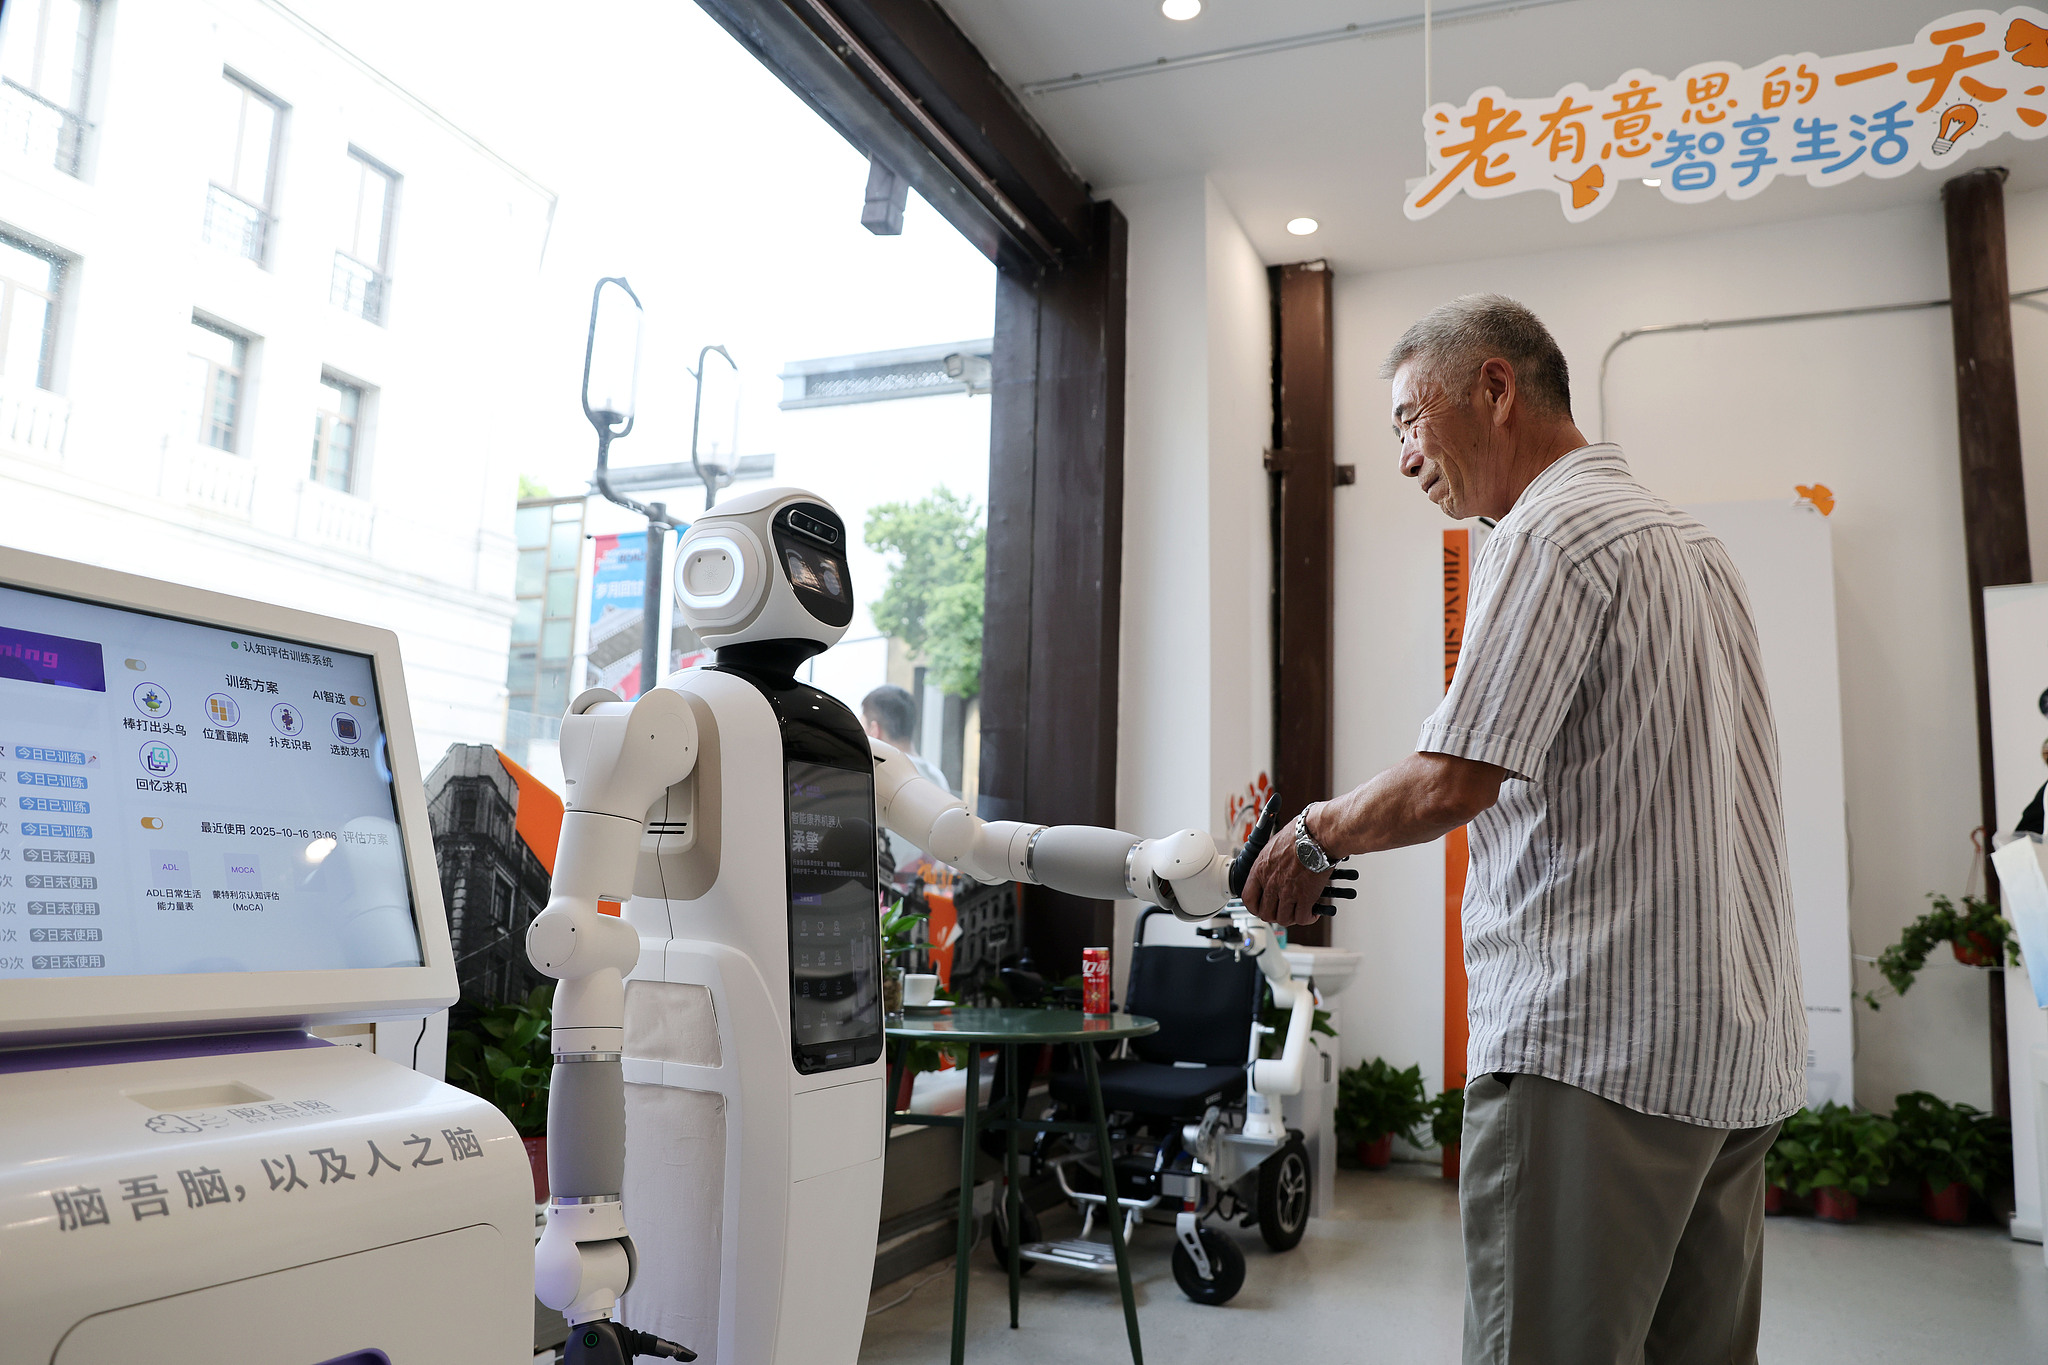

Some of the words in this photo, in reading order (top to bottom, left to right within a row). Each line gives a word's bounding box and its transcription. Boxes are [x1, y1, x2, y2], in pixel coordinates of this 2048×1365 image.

[1415, 22, 2007, 208] 老有意思的一天
[1651, 101, 1914, 191] 智享生活
[243, 641, 333, 668] 认知评估训练系统
[225, 674, 279, 694] 训练方案
[312, 690, 346, 705] AI智选
[123, 717, 187, 736] 棒打出头鸟
[203, 728, 249, 744] 位置翻牌
[269, 736, 312, 751] 扑克识串
[18, 747, 83, 764] 今日已训练
[330, 744, 370, 758] 选数求和
[20, 772, 85, 788] 今日已训练
[136, 778, 188, 794] 回忆求和
[22, 797, 87, 813] 今日已训练
[24, 823, 89, 838] 今日已训练
[201, 821, 246, 835] 最近使用
[250, 826, 309, 839] 2025-10-16
[311, 830, 338, 841] 13:06
[343, 830, 389, 846] 评估方案
[26, 849, 91, 863] 今日未使用
[162, 863, 179, 871] ADL
[231, 866, 255, 874] MOCA
[28, 876, 94, 889] 今日未使用
[146, 889, 202, 899] ADL日常生活
[212, 890, 280, 901] 蒙特利尔认知评估
[0, 901, 17, 914] 次
[30, 902, 96, 915] 今日未使用
[157, 901, 194, 911] 能力量表
[232, 903, 264, 912] (MoCA)
[33, 929, 98, 941] 今日未使用
[35, 956, 101, 968] 今日未使用
